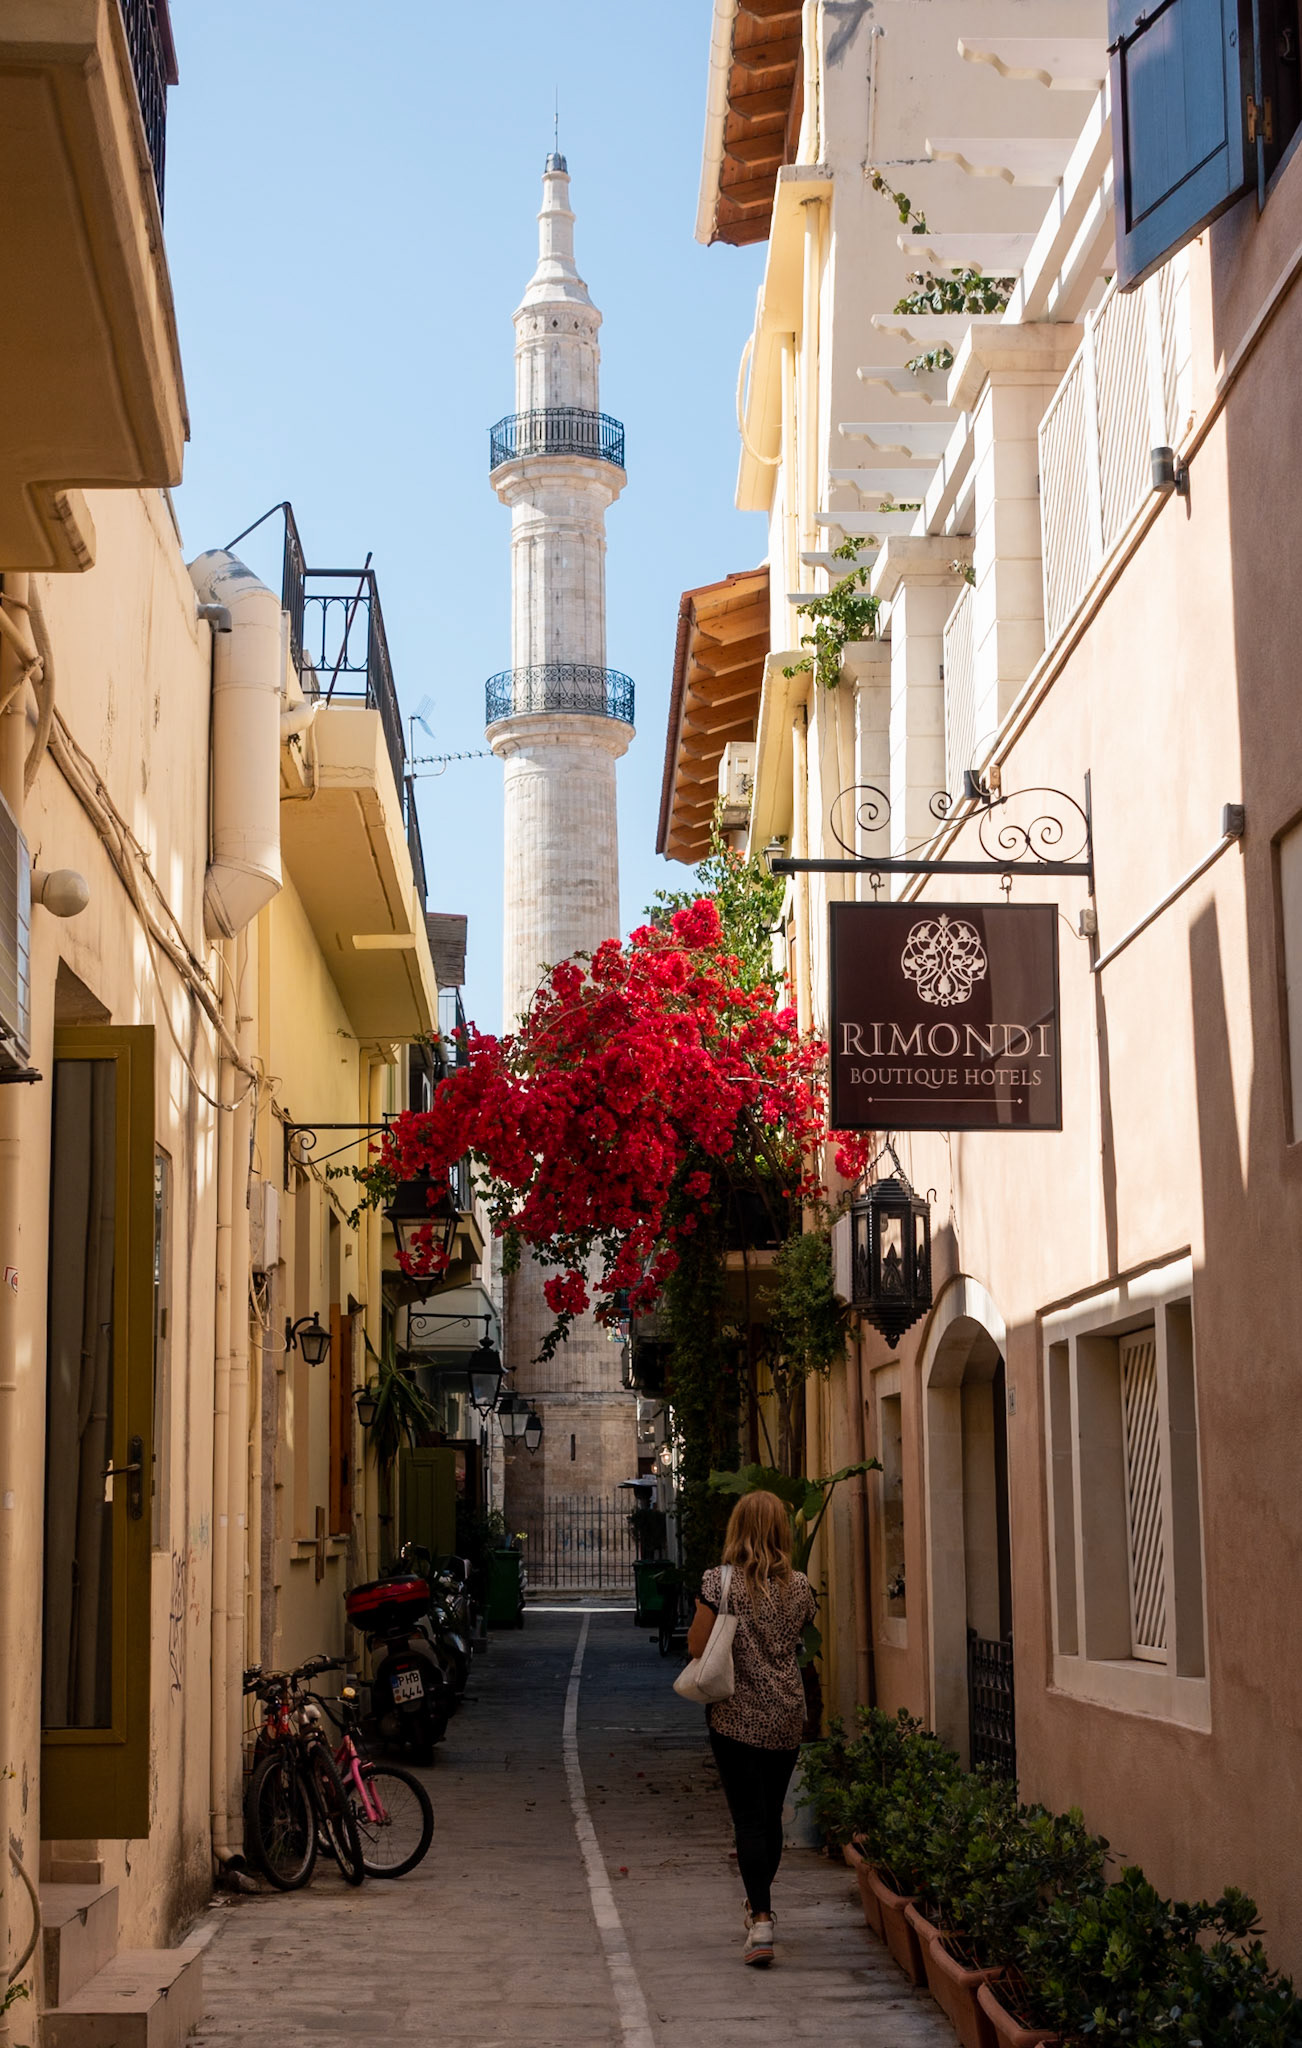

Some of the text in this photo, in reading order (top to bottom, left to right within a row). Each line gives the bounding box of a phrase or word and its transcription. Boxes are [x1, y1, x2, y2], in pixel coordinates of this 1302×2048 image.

[840, 1022, 1051, 1057] RIMONDI
[850, 1067, 1042, 1089] BOUTIQUE HOTELS
